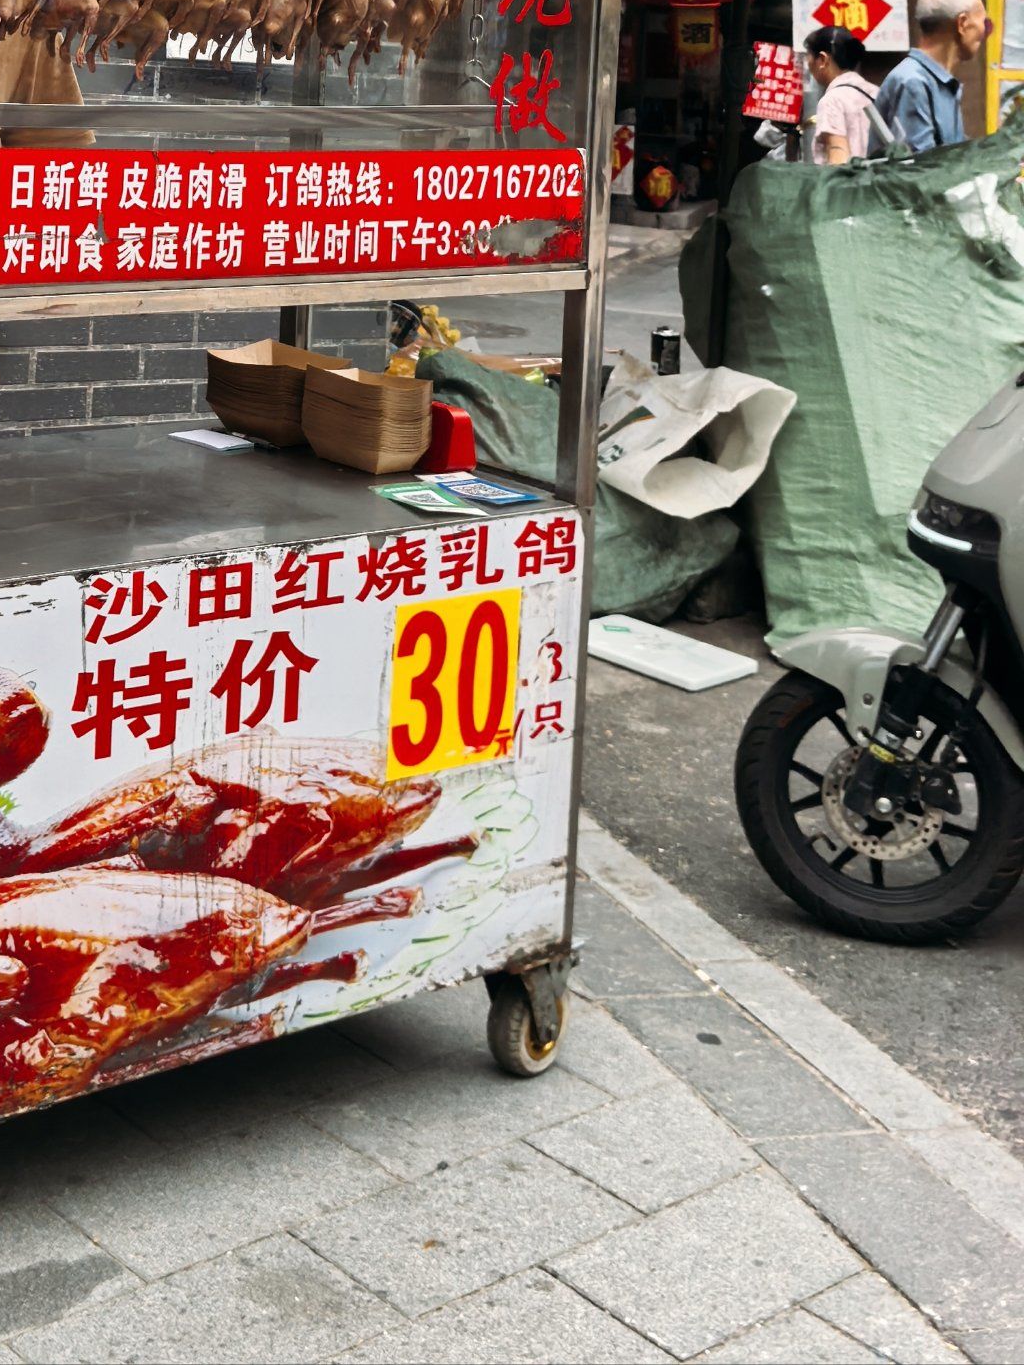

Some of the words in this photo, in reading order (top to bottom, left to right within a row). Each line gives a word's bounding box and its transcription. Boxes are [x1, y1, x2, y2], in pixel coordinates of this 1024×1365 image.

[118, 161, 247, 210] 皮脆肉滑
[413, 163, 579, 202] 18027167202
[115, 221, 245, 272] 家庭作坊
[83, 516, 577, 646] 沙田红烧乳鸽
[70, 630, 319, 761] 特价
